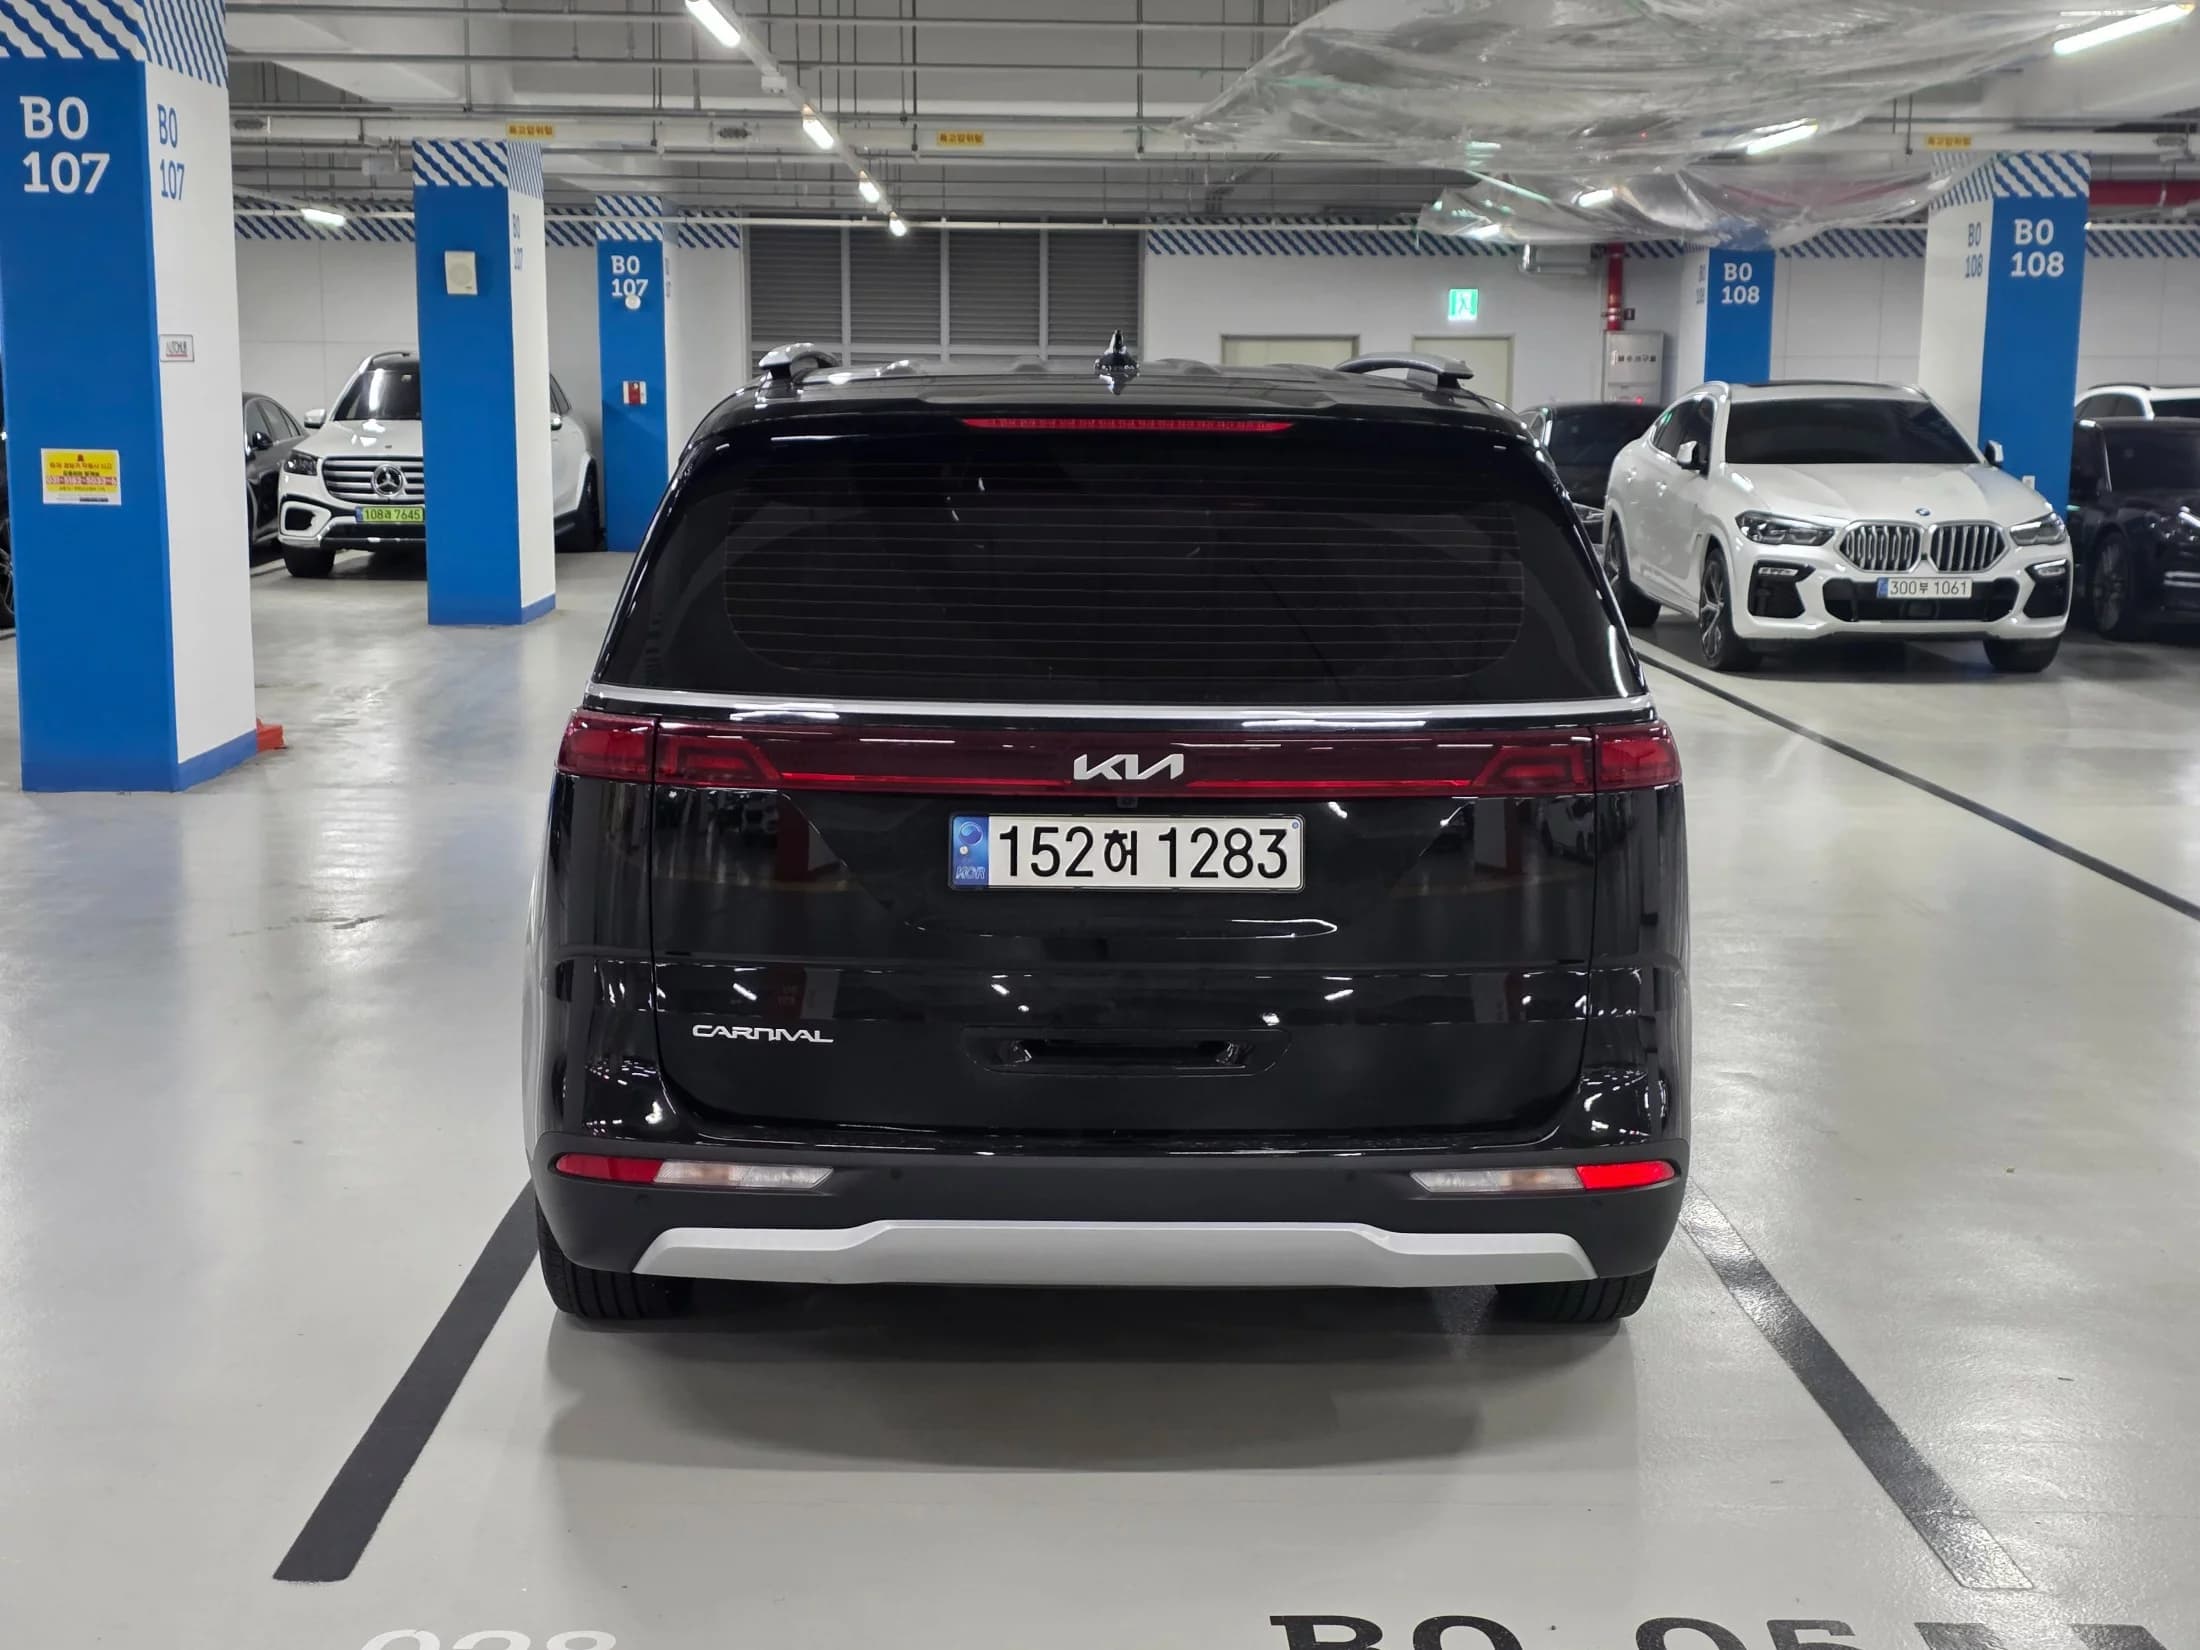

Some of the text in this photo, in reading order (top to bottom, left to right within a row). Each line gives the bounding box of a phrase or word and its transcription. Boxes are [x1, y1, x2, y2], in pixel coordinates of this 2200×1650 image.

[22, 151, 111, 195] 107
[160, 158, 186, 201] 107
[1965, 253, 1984, 279] 108
[2010, 251, 2065, 278] 108
[611, 278, 649, 297] 107
[1721, 285, 1760, 305] 108
[394, 508, 421, 520] 7645
[1934, 580, 1967, 595] 1061
[1073, 753, 1184, 780] KIA
[999, 825, 1288, 879] 152허 1283
[692, 1024, 834, 1043] CARNIVAL
